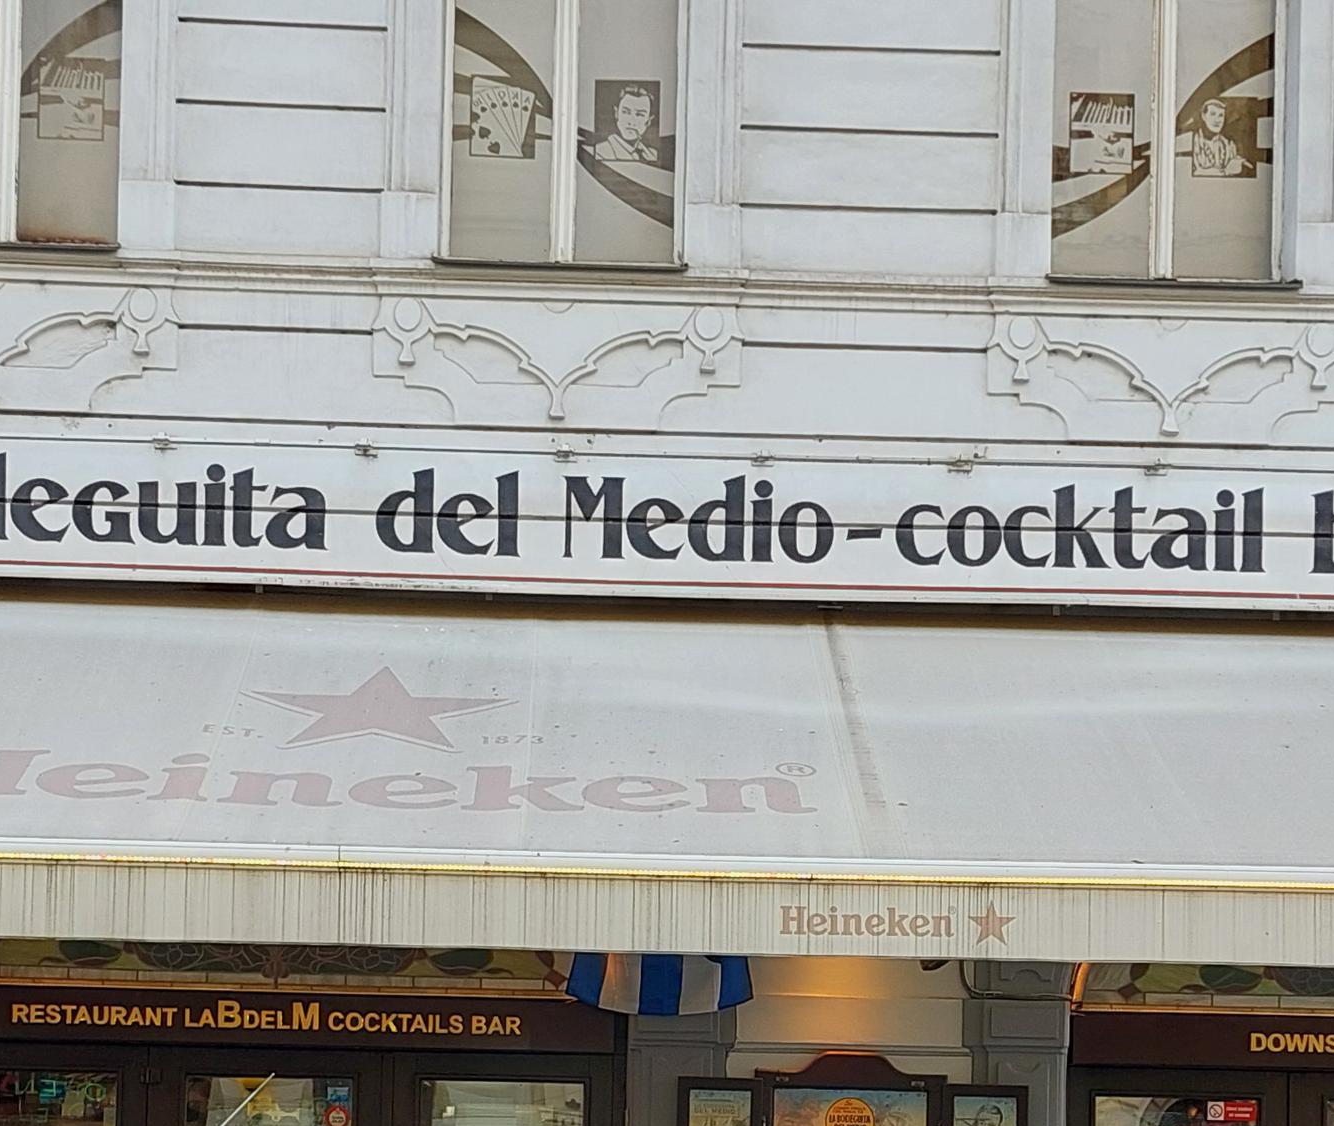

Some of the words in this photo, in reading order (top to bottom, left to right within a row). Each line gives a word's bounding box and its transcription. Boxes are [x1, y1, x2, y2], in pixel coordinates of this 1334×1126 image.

[376, 468, 519, 559] del
[202, 723, 264, 738] EST.
[481, 735, 545, 745] 1873
[12, 1004, 178, 1028] RESTAURANT
[328, 1011, 463, 1034] COCKTAILS
[472, 1016, 522, 1036] BAR
